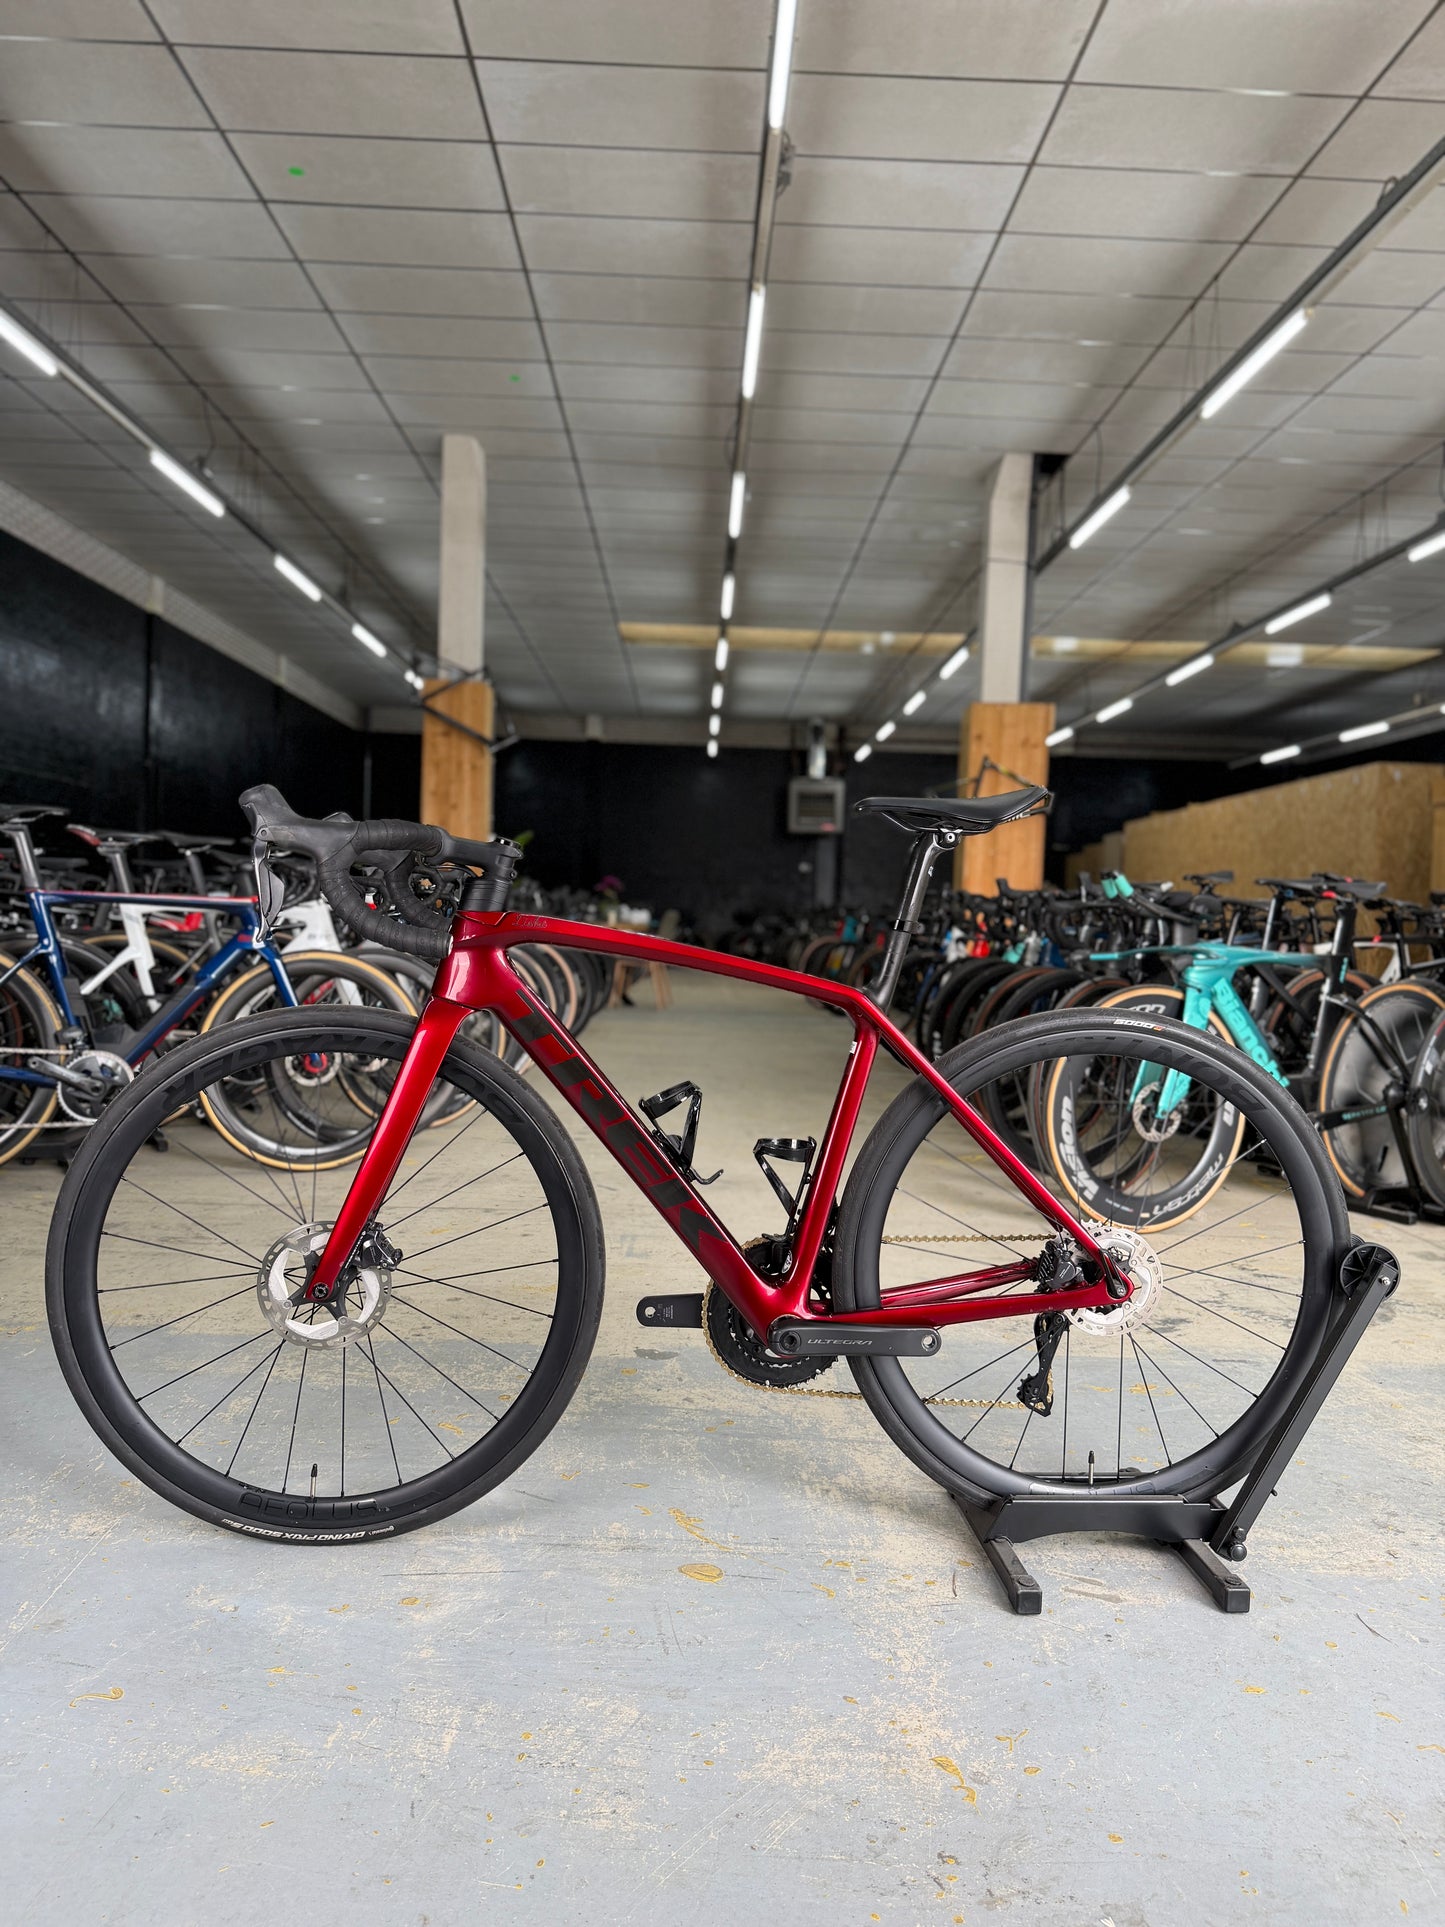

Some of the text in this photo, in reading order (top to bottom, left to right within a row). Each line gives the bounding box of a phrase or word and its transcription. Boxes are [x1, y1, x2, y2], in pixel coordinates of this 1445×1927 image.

[510, 989, 728, 1252] TREK
[239, 1492, 378, 1520] AEOLUS
[242, 1525, 283, 1538] 5000
[283, 1532, 316, 1541] PRIX
[316, 1531, 367, 1541] GRAND
